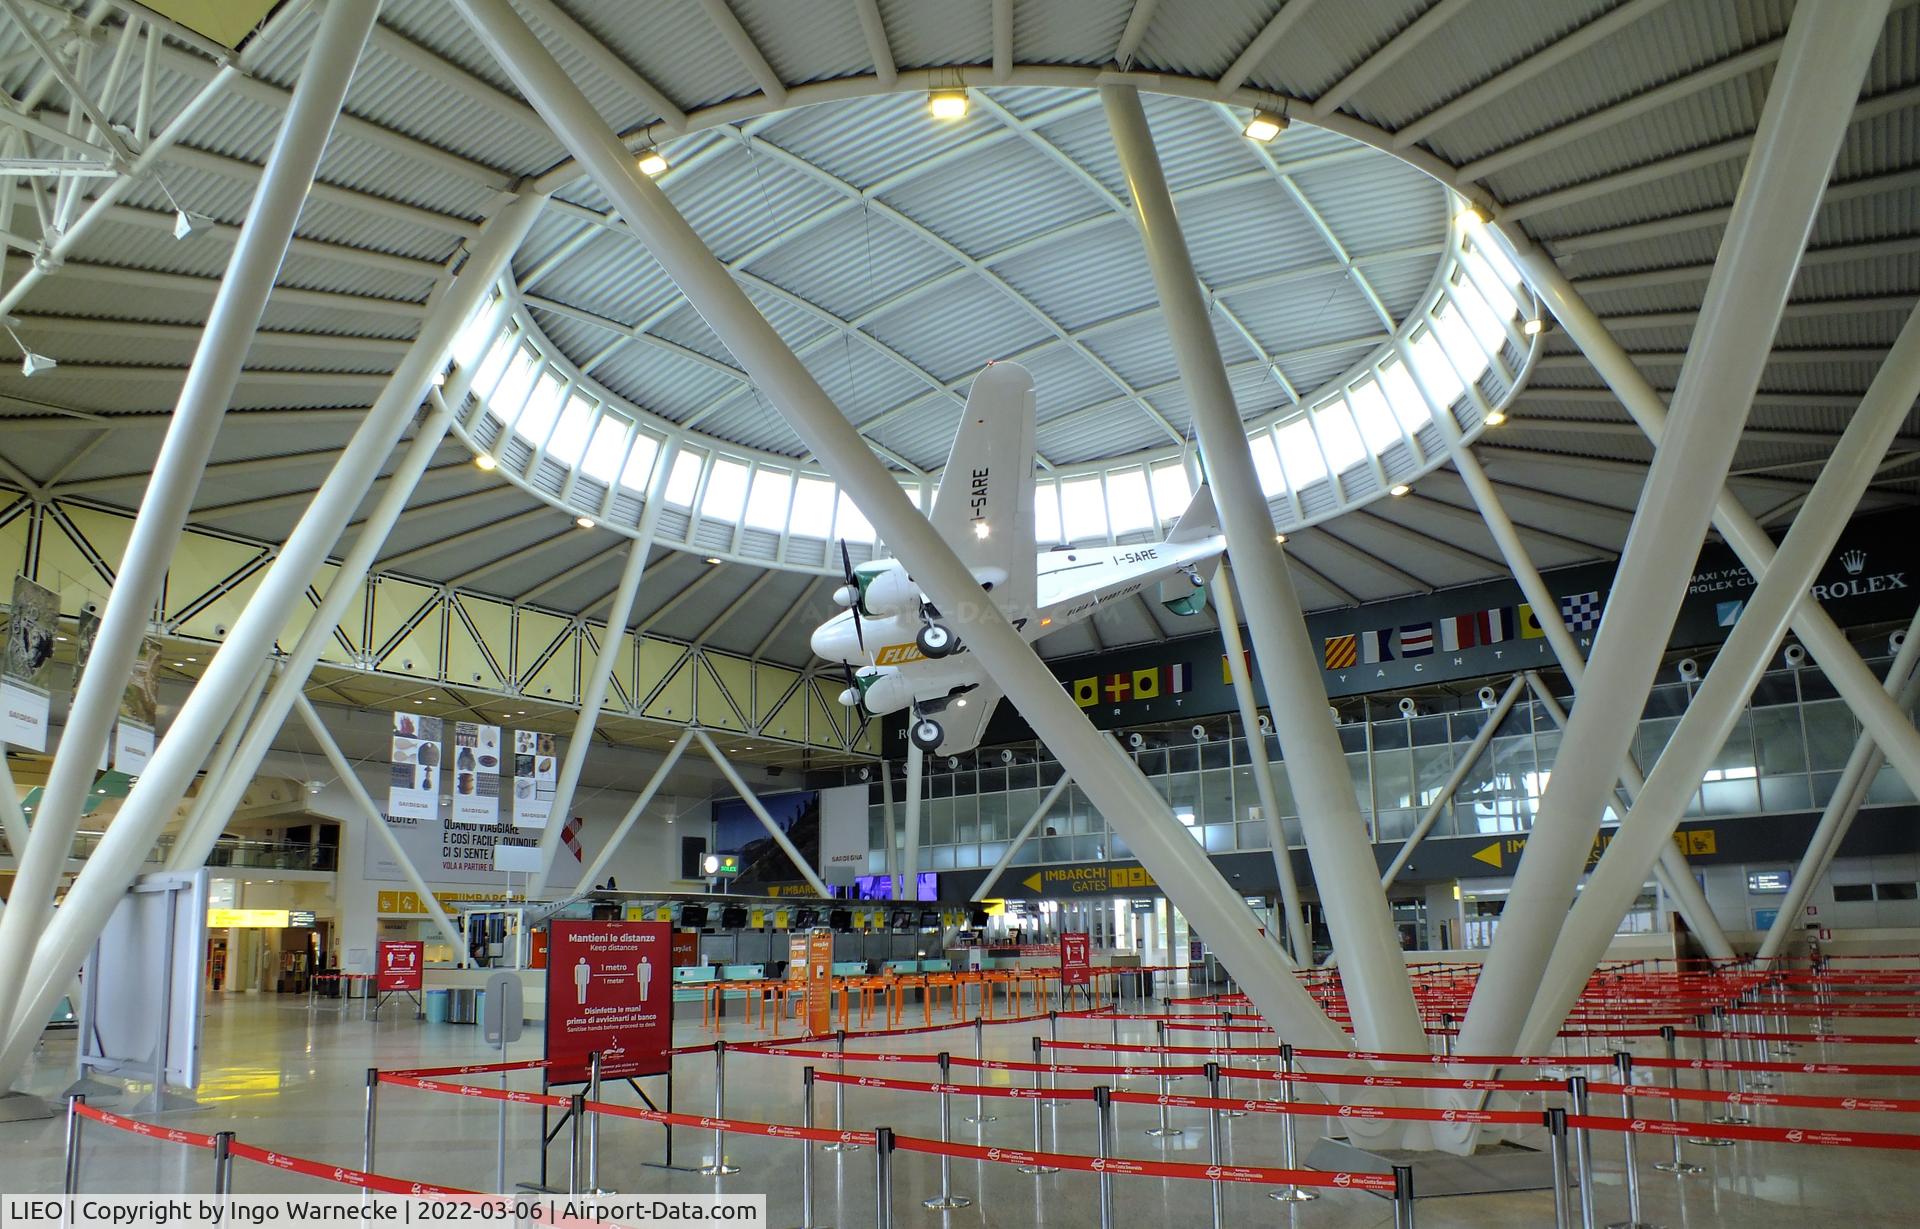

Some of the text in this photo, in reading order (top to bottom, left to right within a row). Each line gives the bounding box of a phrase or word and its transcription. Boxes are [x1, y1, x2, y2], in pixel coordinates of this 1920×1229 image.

[970, 467, 989, 521] I-SARE
[1113, 548, 1158, 566] I-SARE
[1689, 568, 1748, 583] MAXI YAC
[1689, 576, 1756, 594] ROLEX CU
[1811, 572, 1908, 600] ROLEX
[444, 818, 520, 835] QUANDO VIAGGIARE
[451, 832, 470, 844] COSÌ
[443, 847, 488, 860] CI SI SENTE
[831, 854, 863, 862] SARDEGNA
[442, 862, 458, 870] VOLA
[458, 862, 463, 870] A
[463, 862, 487, 871] PARTIRE
[1045, 867, 1106, 881] IMBARCHI
[783, 884, 818, 895] IMBARC
[1072, 880, 1106, 892] GATES
[569, 933, 656, 942] Mantieni le distanze
[590, 944, 607, 952] Keep
[584, 1007, 617, 1015] Disinfetta
[566, 1017, 587, 1026] prima
[588, 1016, 595, 1024] di
[596, 1014, 630, 1023] avvicinarti
[637, 1013, 656, 1021] banco
